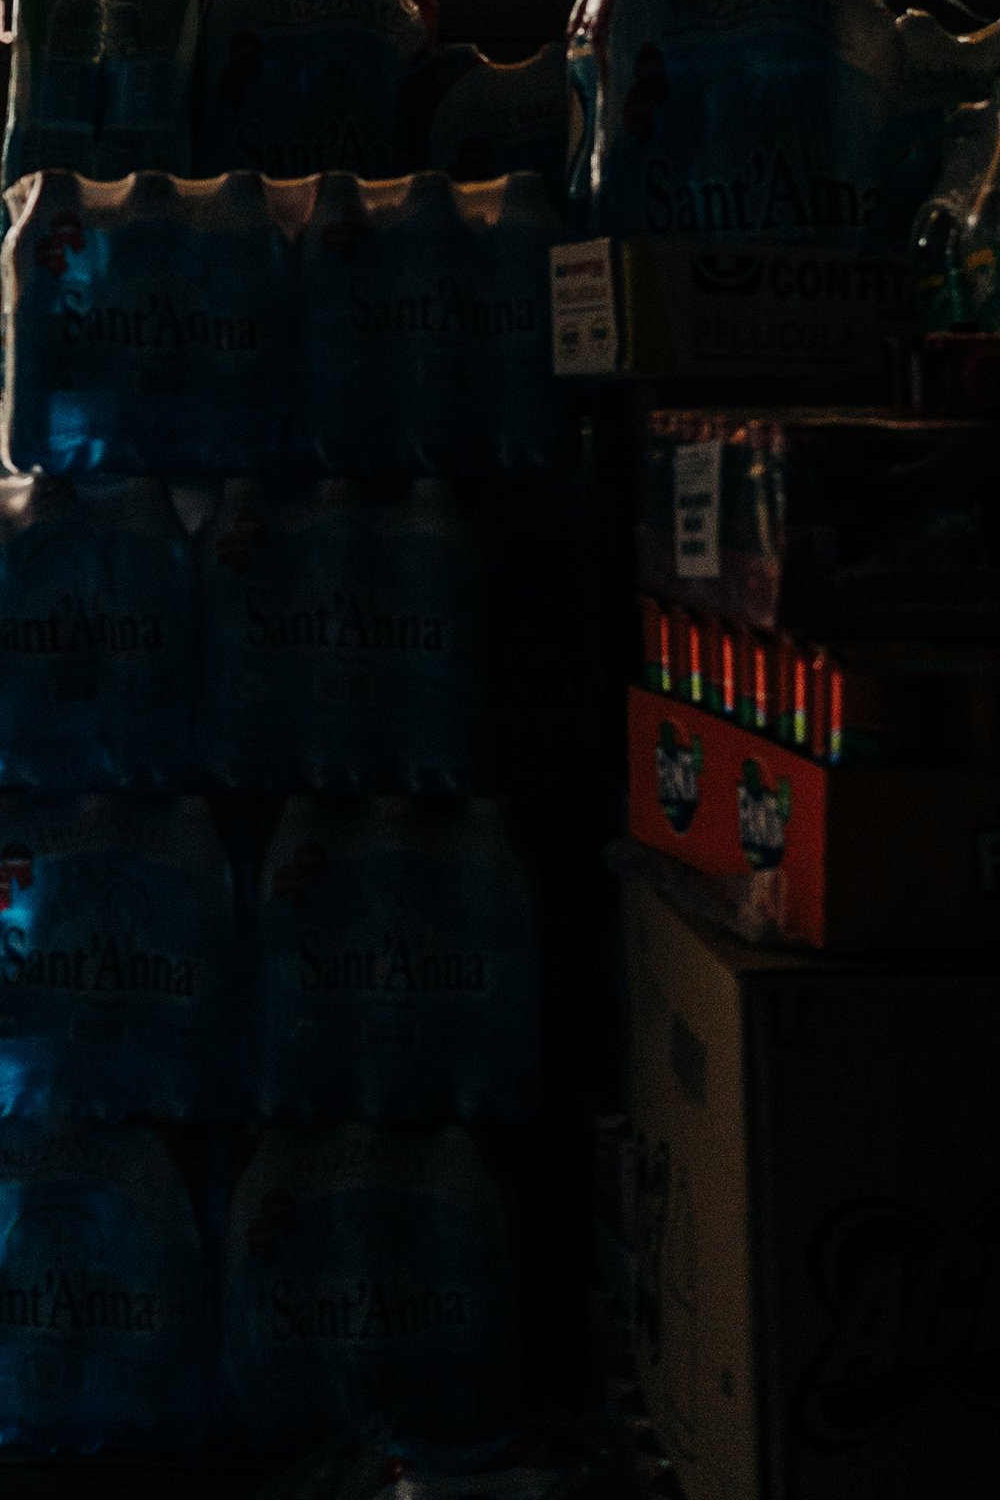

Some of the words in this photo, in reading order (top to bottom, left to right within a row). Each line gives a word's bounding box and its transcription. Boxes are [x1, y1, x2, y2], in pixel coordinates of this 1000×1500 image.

[244, 587, 446, 653] Sant'Anna
[3, 928, 198, 999] Sant'Anna
[300, 926, 489, 993] Sant'Anna
[271, 1278, 471, 1341] Sant'Anna
[818, 1235, 1000, 1386] AC
